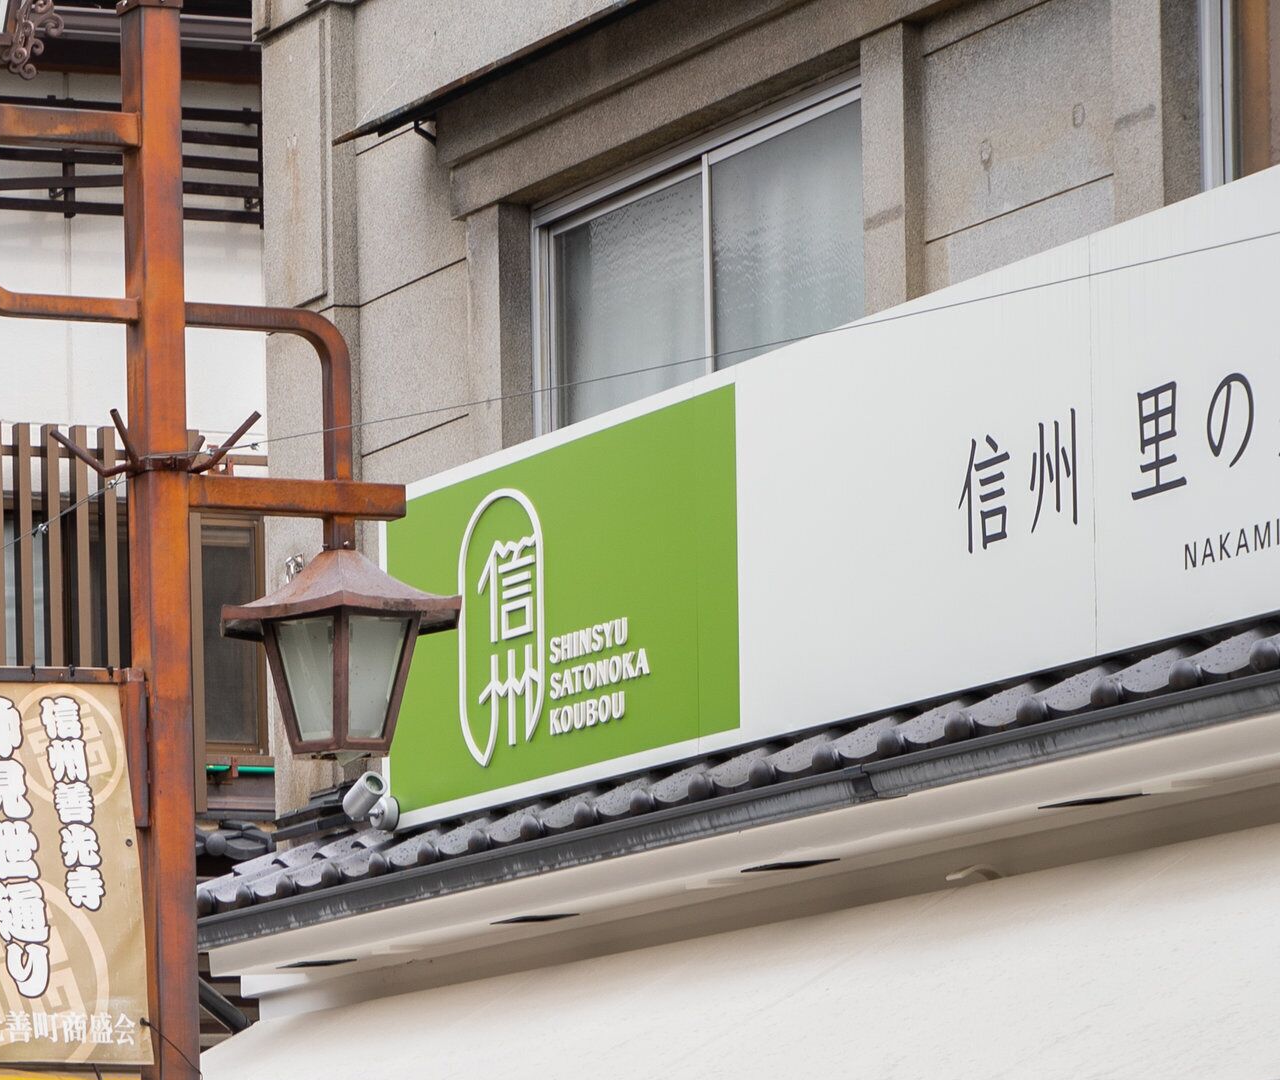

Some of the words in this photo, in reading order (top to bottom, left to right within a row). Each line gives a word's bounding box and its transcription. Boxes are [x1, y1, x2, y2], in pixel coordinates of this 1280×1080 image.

[959, 408, 1079, 554] 信州
[549, 617, 629, 666] SHINSYU
[549, 647, 650, 702] SATONOKA
[549, 691, 626, 737] KOUBOU
[40, 697, 106, 911] 信州善光寺
